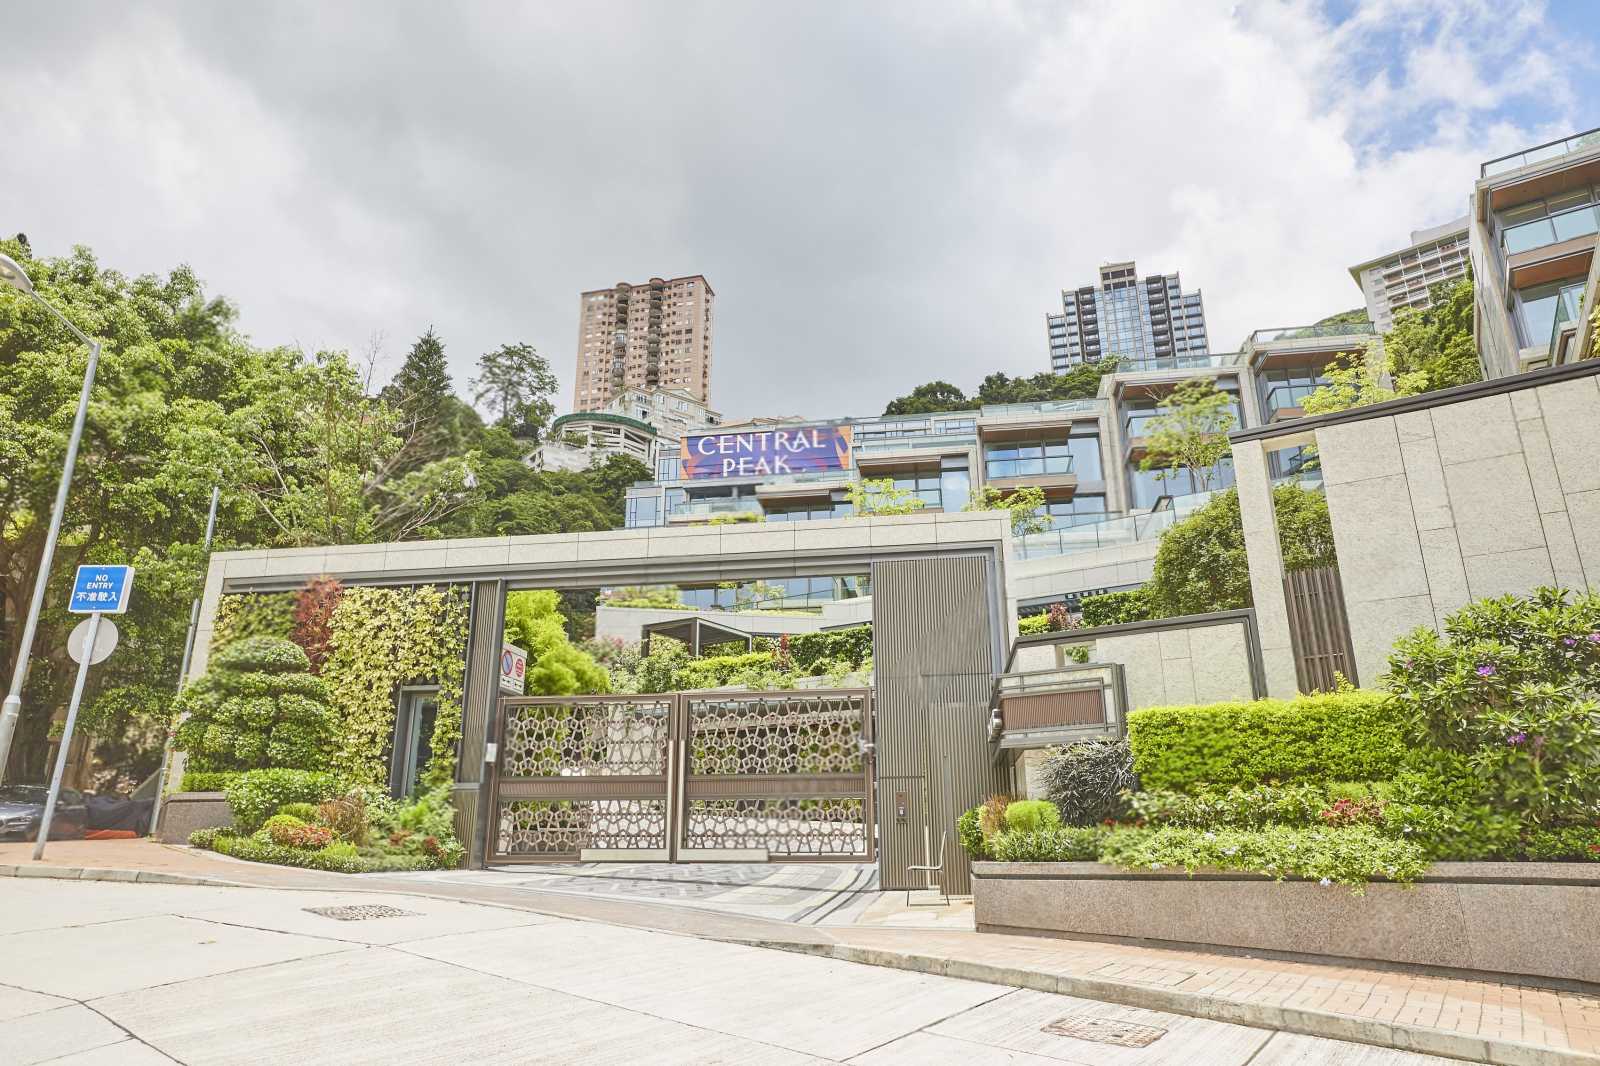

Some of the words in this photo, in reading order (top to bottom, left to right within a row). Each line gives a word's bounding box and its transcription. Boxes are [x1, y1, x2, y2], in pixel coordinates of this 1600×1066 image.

[697, 429, 827, 456] CENTRAL
[722, 454, 792, 477] PEAK
[86, 582, 114, 590] ENTRY
